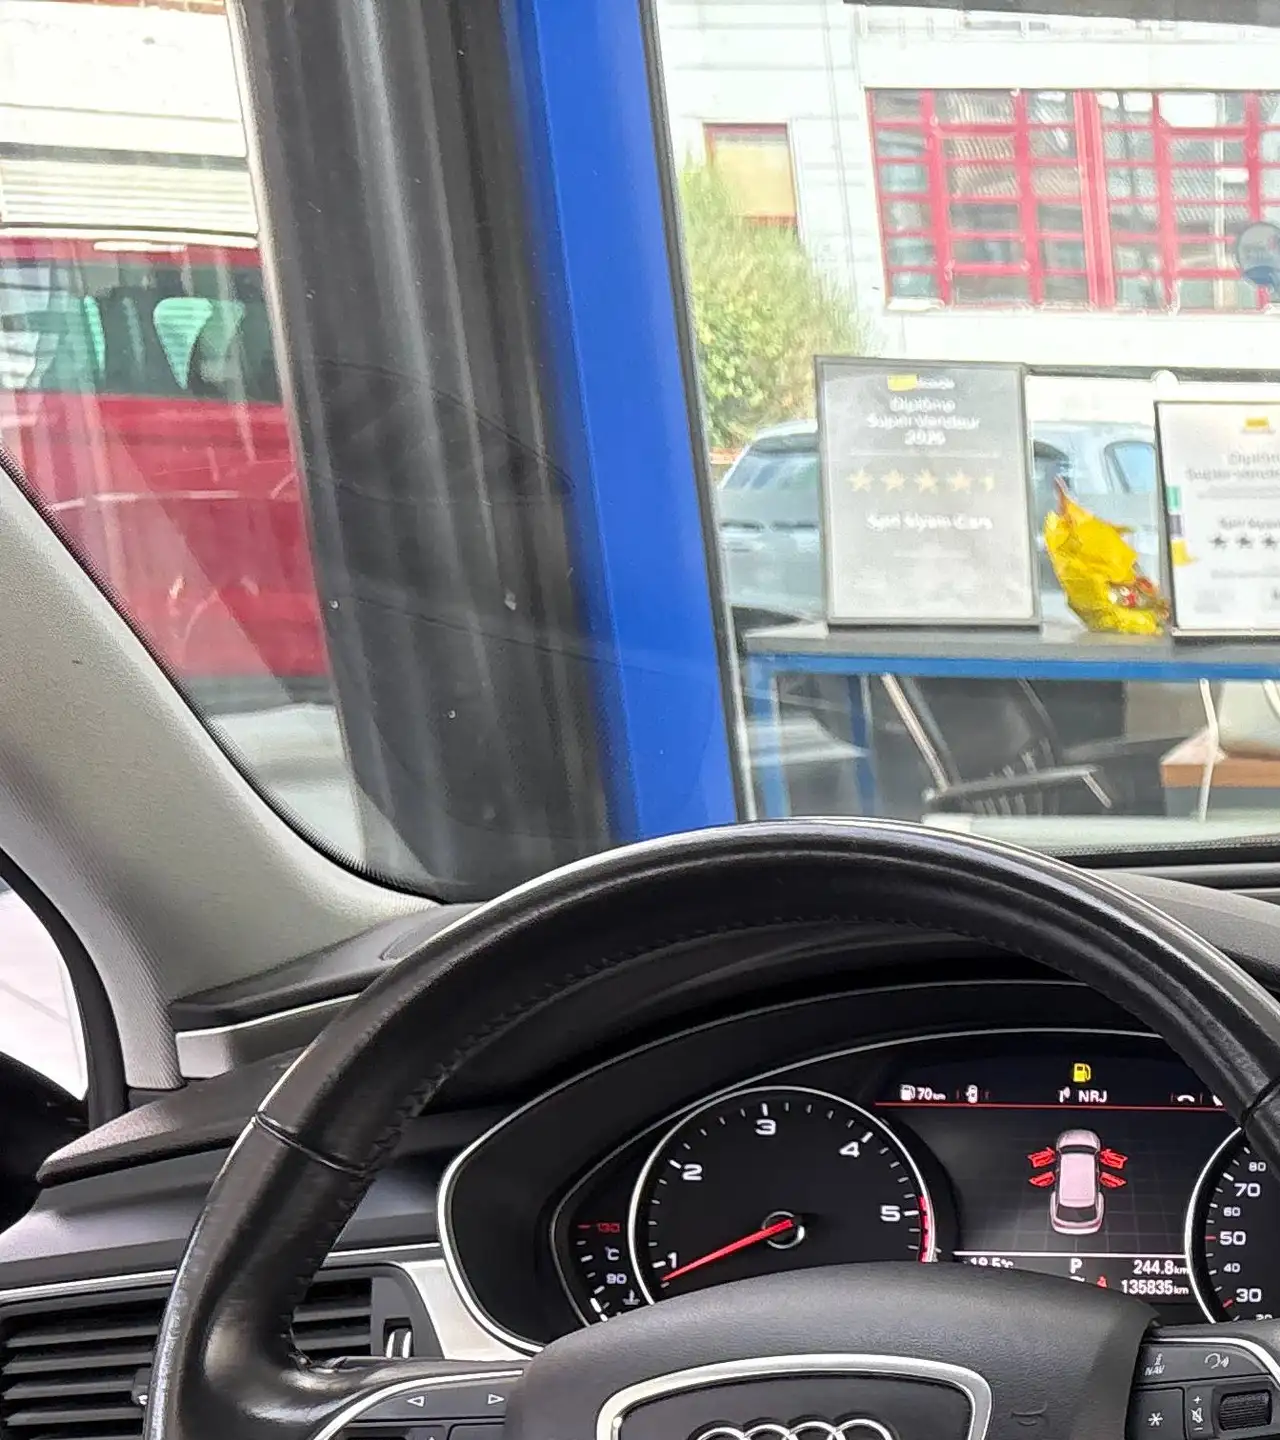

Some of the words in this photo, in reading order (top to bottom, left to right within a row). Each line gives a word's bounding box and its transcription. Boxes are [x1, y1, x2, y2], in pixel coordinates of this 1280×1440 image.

[1078, 1089, 1108, 1104] NRJ
[755, 1118, 777, 1136] 3
[839, 1141, 861, 1158] 4
[681, 1163, 703, 1181] 2
[1248, 1160, 1267, 1173] 80
[1234, 1182, 1262, 1198] 70
[880, 1205, 901, 1222] 5
[1223, 1206, 1241, 1218] 60
[1219, 1230, 1247, 1246] 50
[667, 1251, 678, 1269] 1
[1068, 1257, 1083, 1275] P
[1223, 1261, 1241, 1274] 40
[606, 1272, 628, 1285] 90
[1236, 1287, 1262, 1303] 30
[1145, 1365, 1165, 1376] NAV
